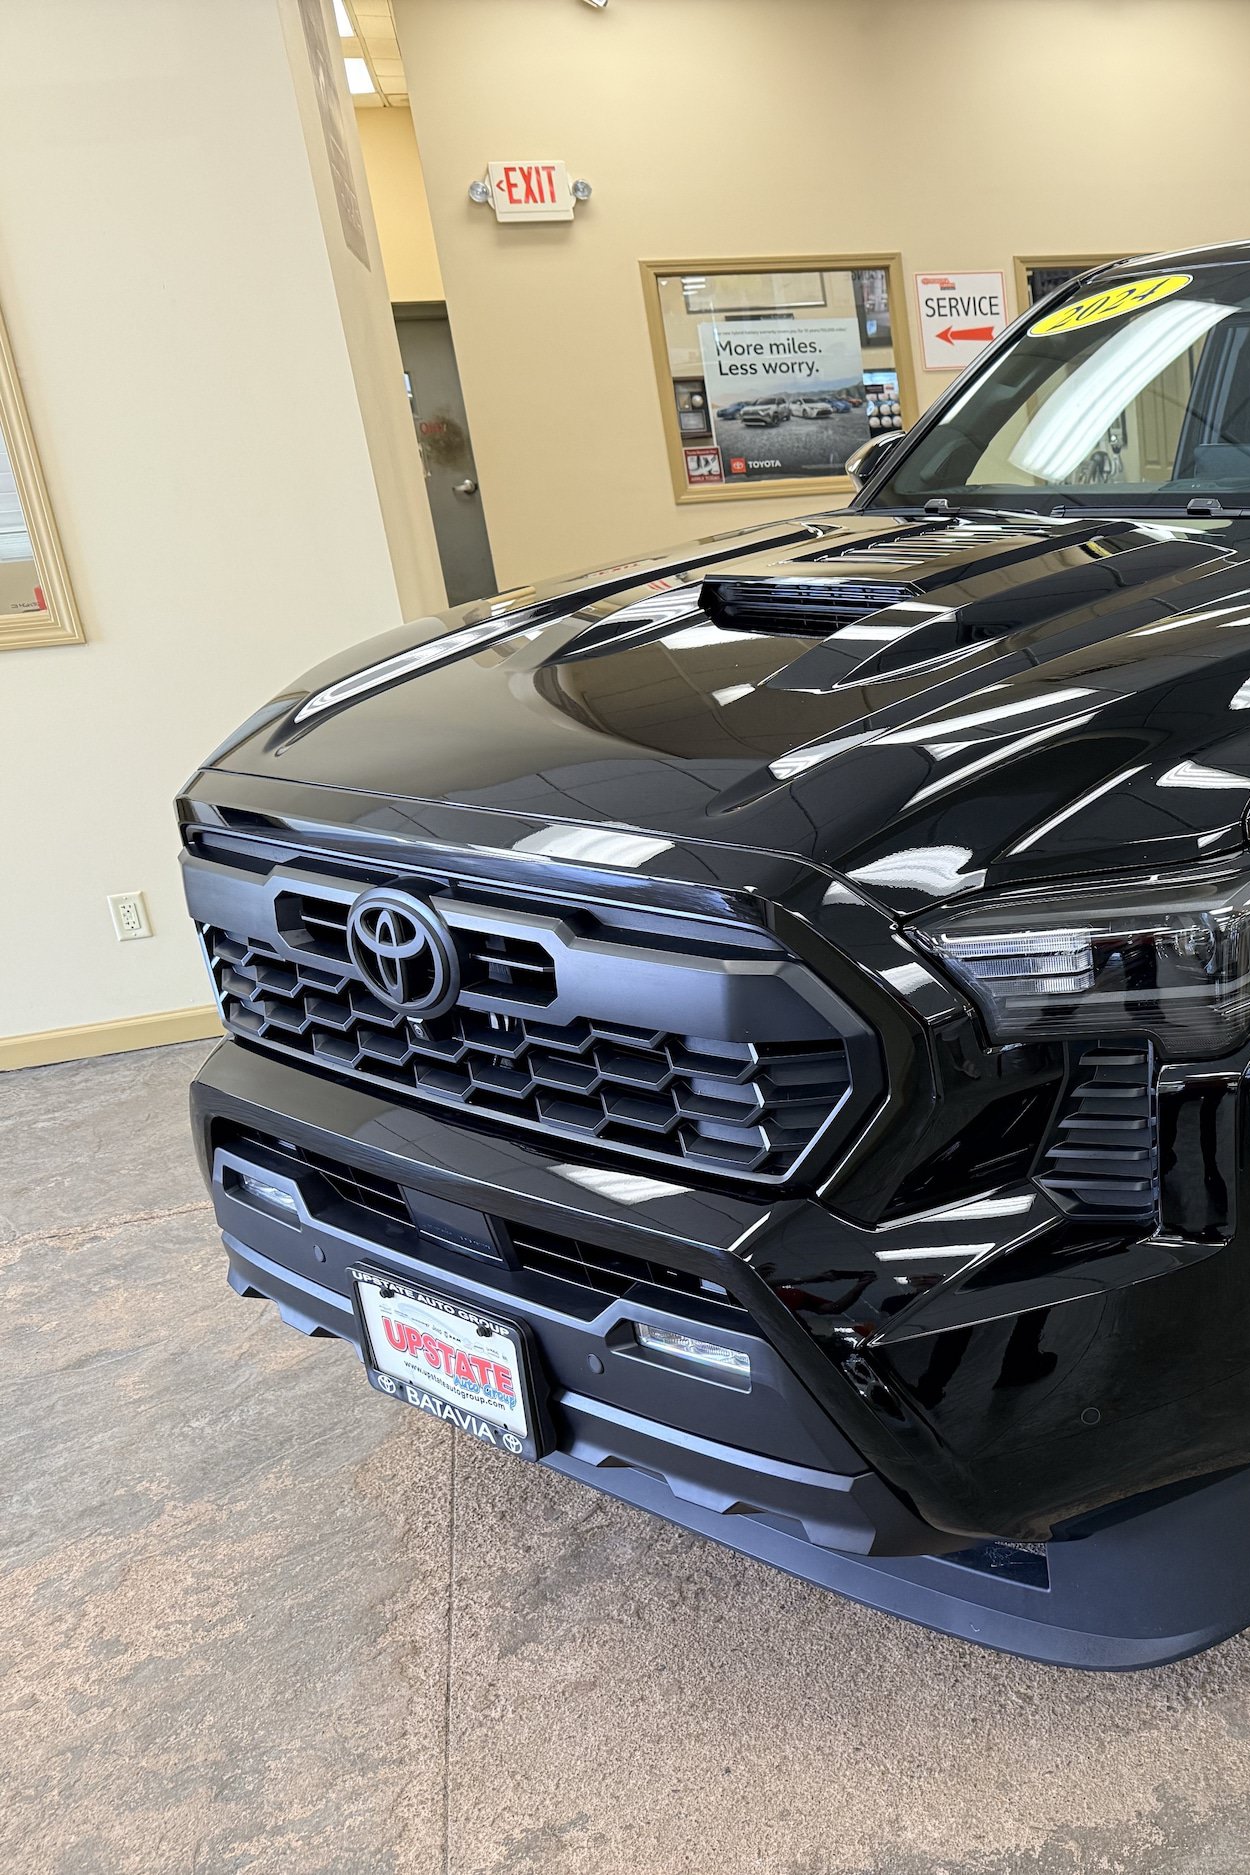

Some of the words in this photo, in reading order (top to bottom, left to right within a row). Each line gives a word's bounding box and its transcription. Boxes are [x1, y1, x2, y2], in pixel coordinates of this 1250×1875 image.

[503, 165, 556, 205] EXIT
[925, 295, 1000, 318] SERVICE
[1046, 278, 1171, 332] 2024
[716, 339, 764, 357] More
[769, 337, 822, 356] miles.
[718, 359, 758, 376] Less
[762, 360, 820, 377] worry.
[747, 459, 782, 469] TOYOTA
[352, 1270, 415, 1297] UPSTATE
[418, 1295, 456, 1314] AUTO
[458, 1309, 510, 1336] GROUP
[382, 1314, 515, 1397] UPSTATE
[403, 1359, 507, 1412] www.upstateautogroup.com
[453, 1375, 480, 1395] Auto
[483, 1383, 518, 1410] Group
[406, 1385, 498, 1445] BATAVIA
